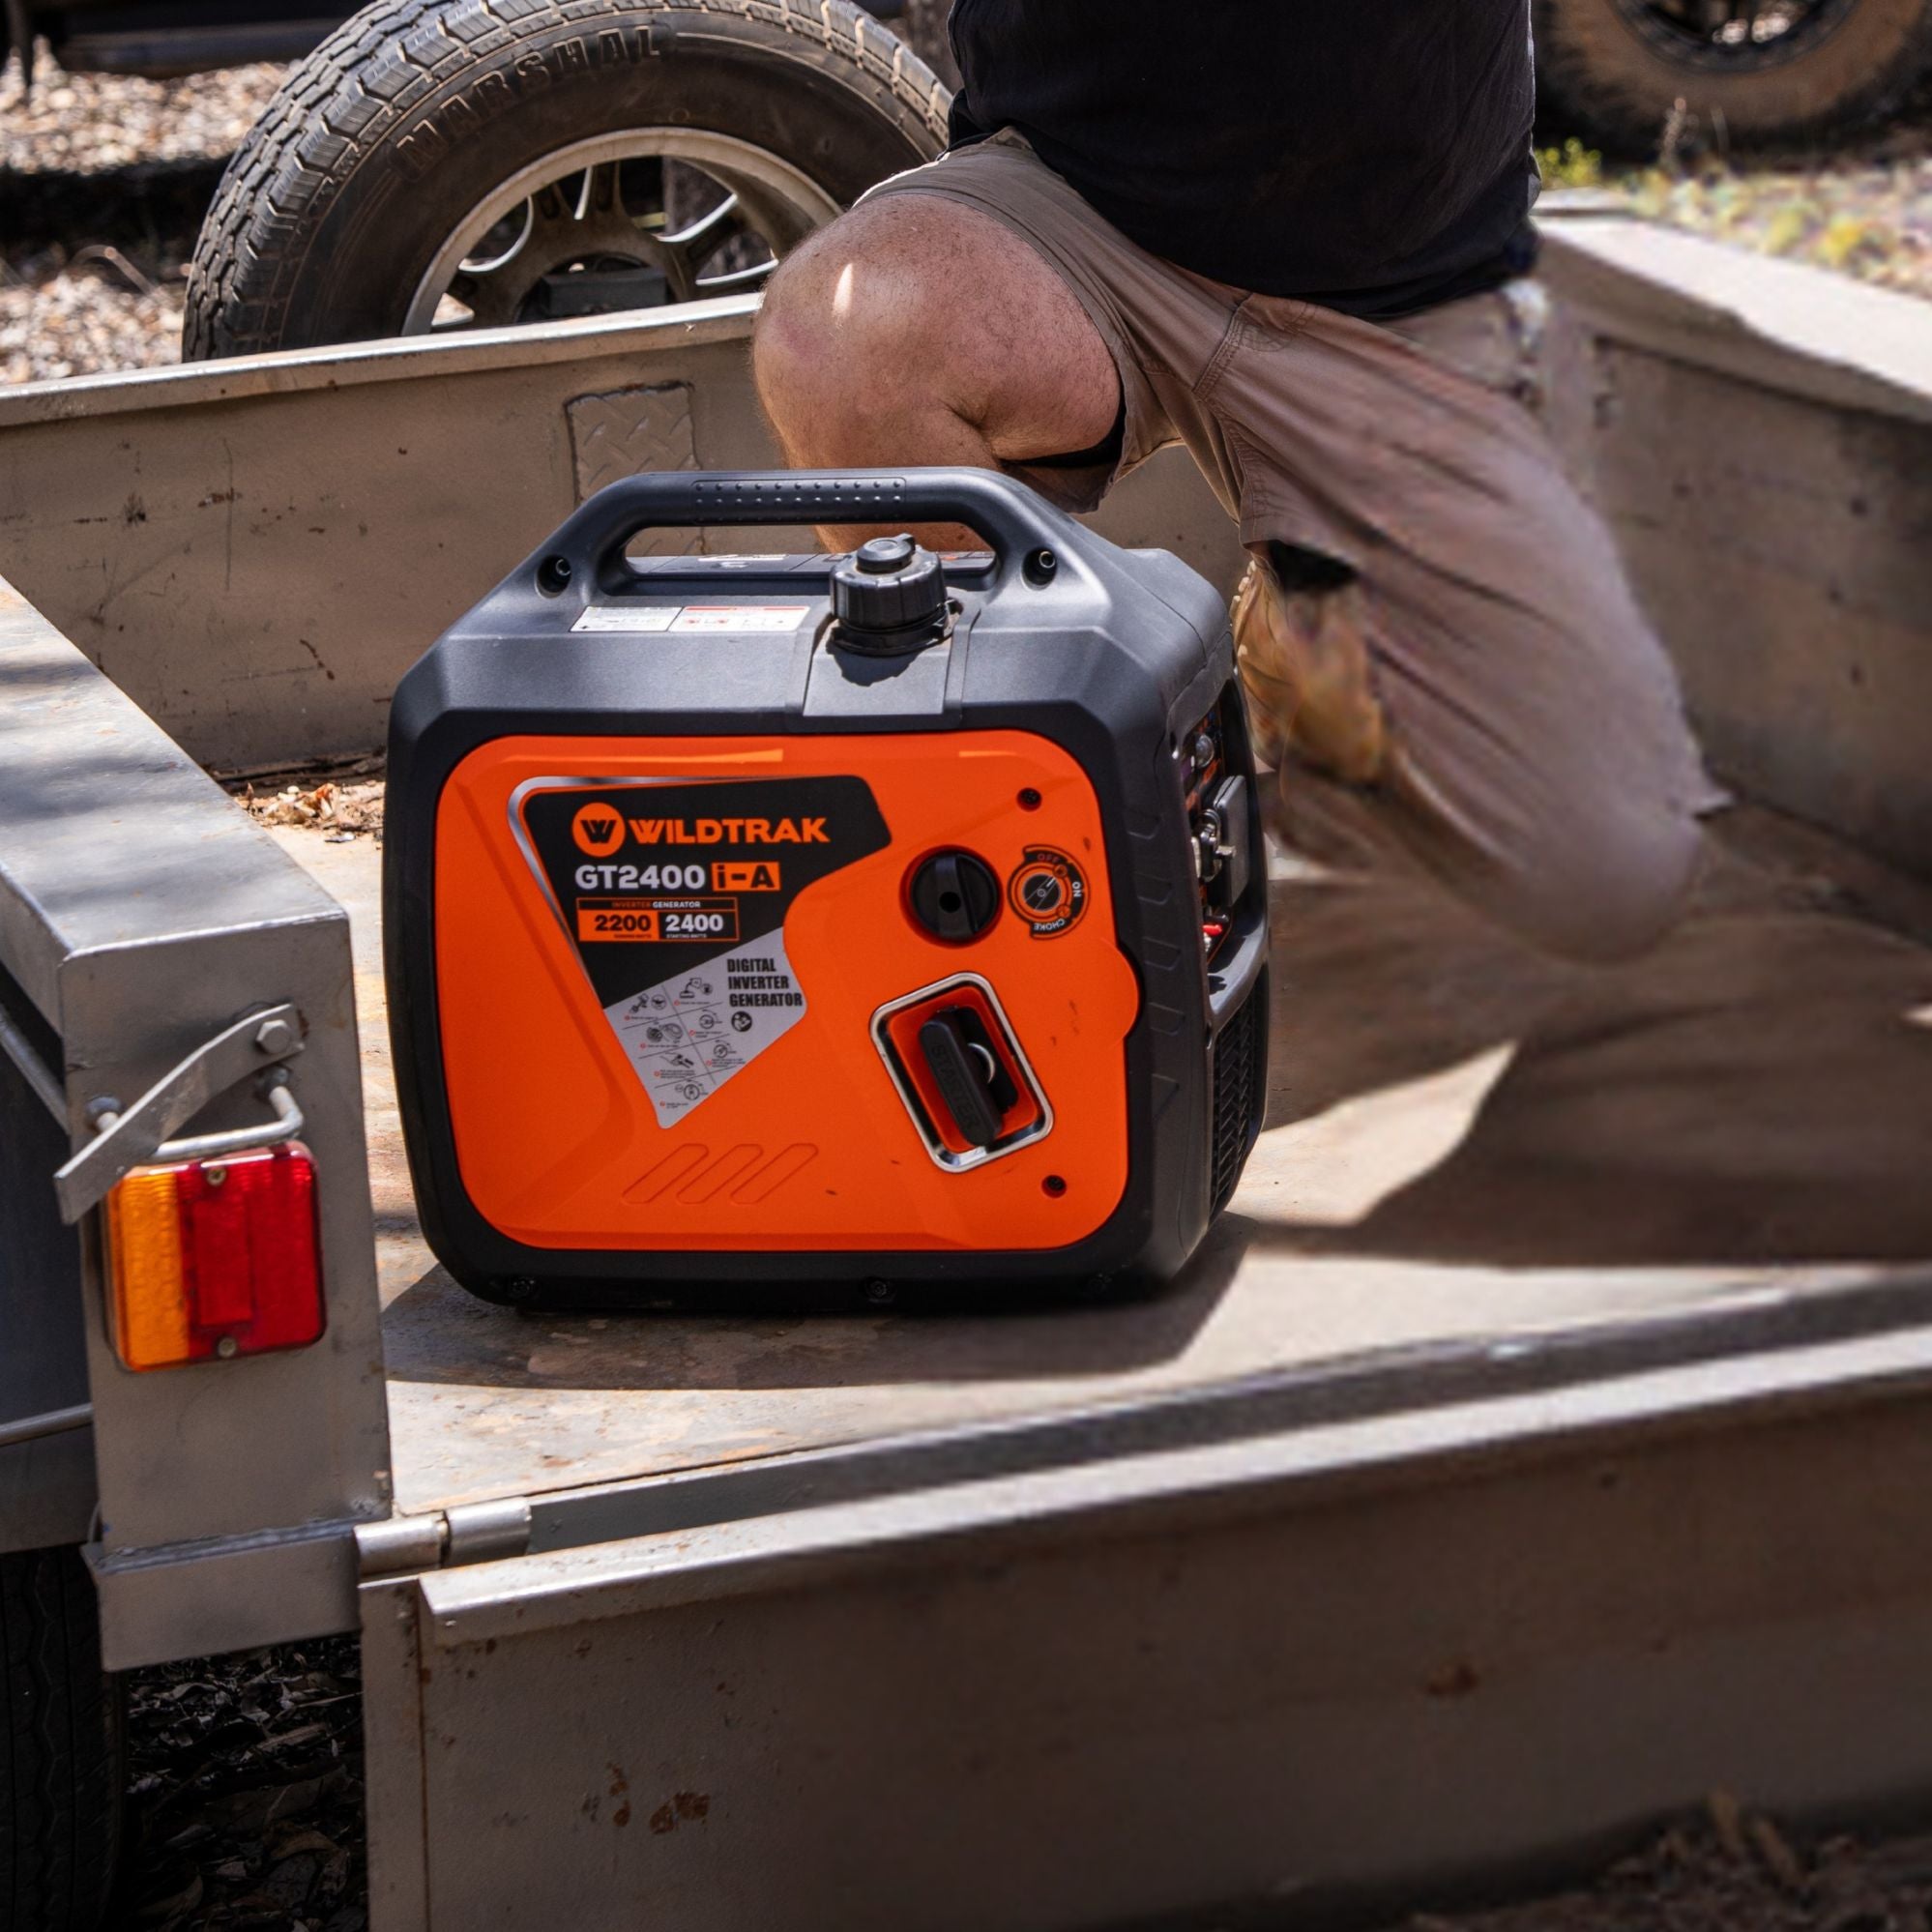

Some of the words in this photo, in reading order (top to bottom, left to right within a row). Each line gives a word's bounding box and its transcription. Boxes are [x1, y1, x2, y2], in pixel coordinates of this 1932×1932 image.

[395, 24, 661, 174] MARSHAL
[629, 817, 831, 845] WILDTRAK
[1037, 853, 1061, 864] OFF
[574, 864, 706, 891] GT2400
[1071, 881, 1082, 898] ON
[652, 900, 702, 909] GENERATOR
[594, 914, 653, 932] 2200
[664, 913, 724, 933] 2400
[1033, 918, 1066, 931] CHOKE
[726, 958, 777, 974] DIGITAL
[727, 976, 790, 990] INVERTER
[728, 993, 804, 1008] GENERATOR
